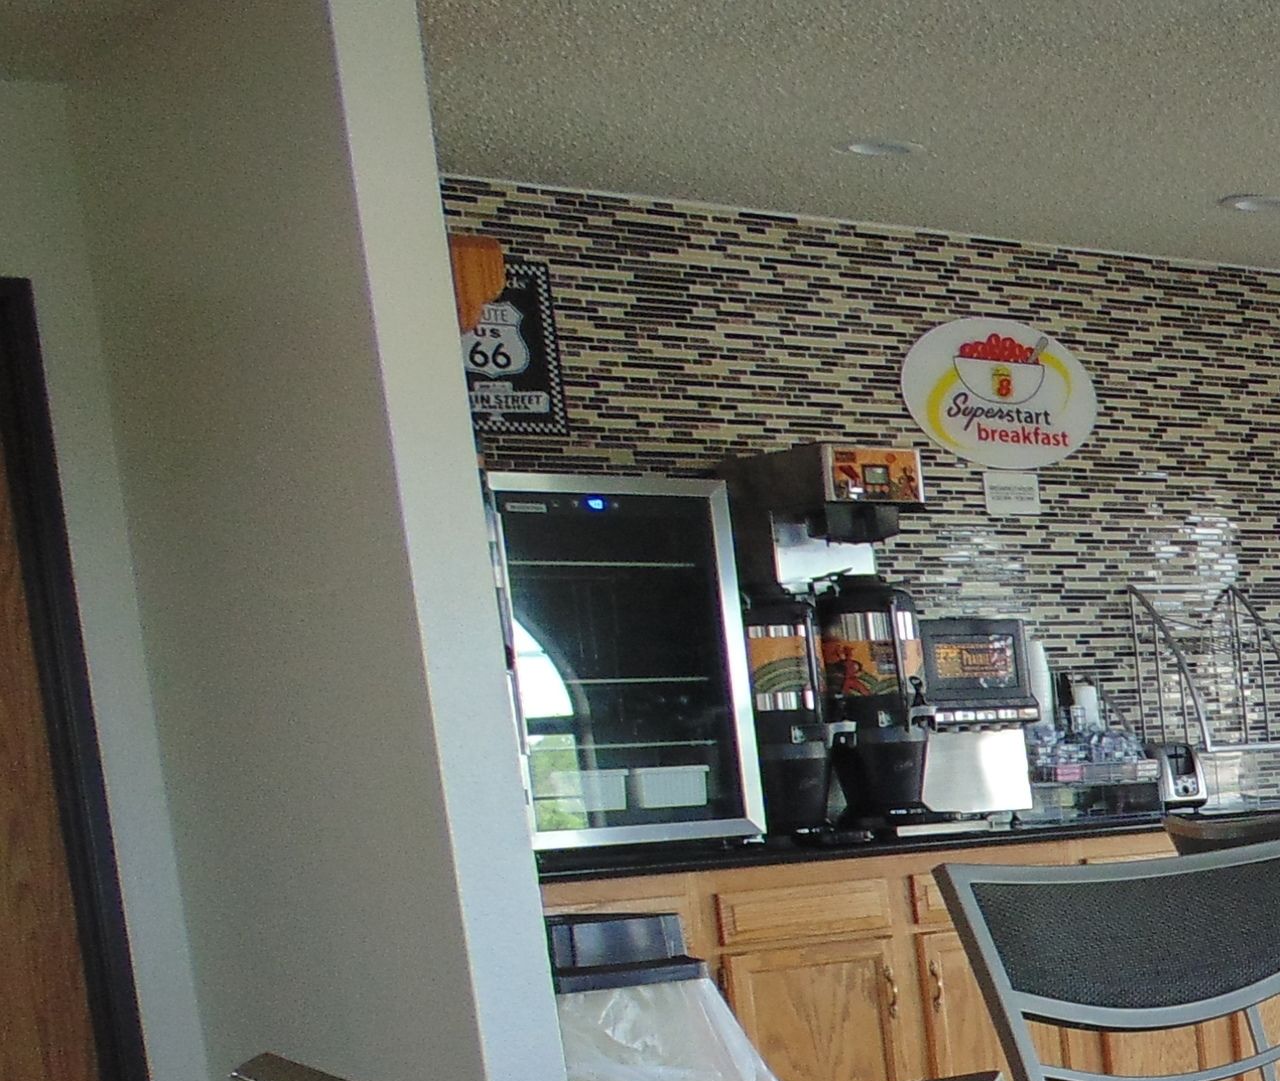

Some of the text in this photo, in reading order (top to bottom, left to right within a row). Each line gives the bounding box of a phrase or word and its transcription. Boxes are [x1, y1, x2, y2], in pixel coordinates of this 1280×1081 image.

[482, 307, 508, 322] UTE
[473, 327, 501, 339] US
[469, 341, 512, 369] 66
[494, 394, 543, 405] STREET
[947, 391, 1052, 431] Superstart
[976, 422, 1070, 448] breakfast
